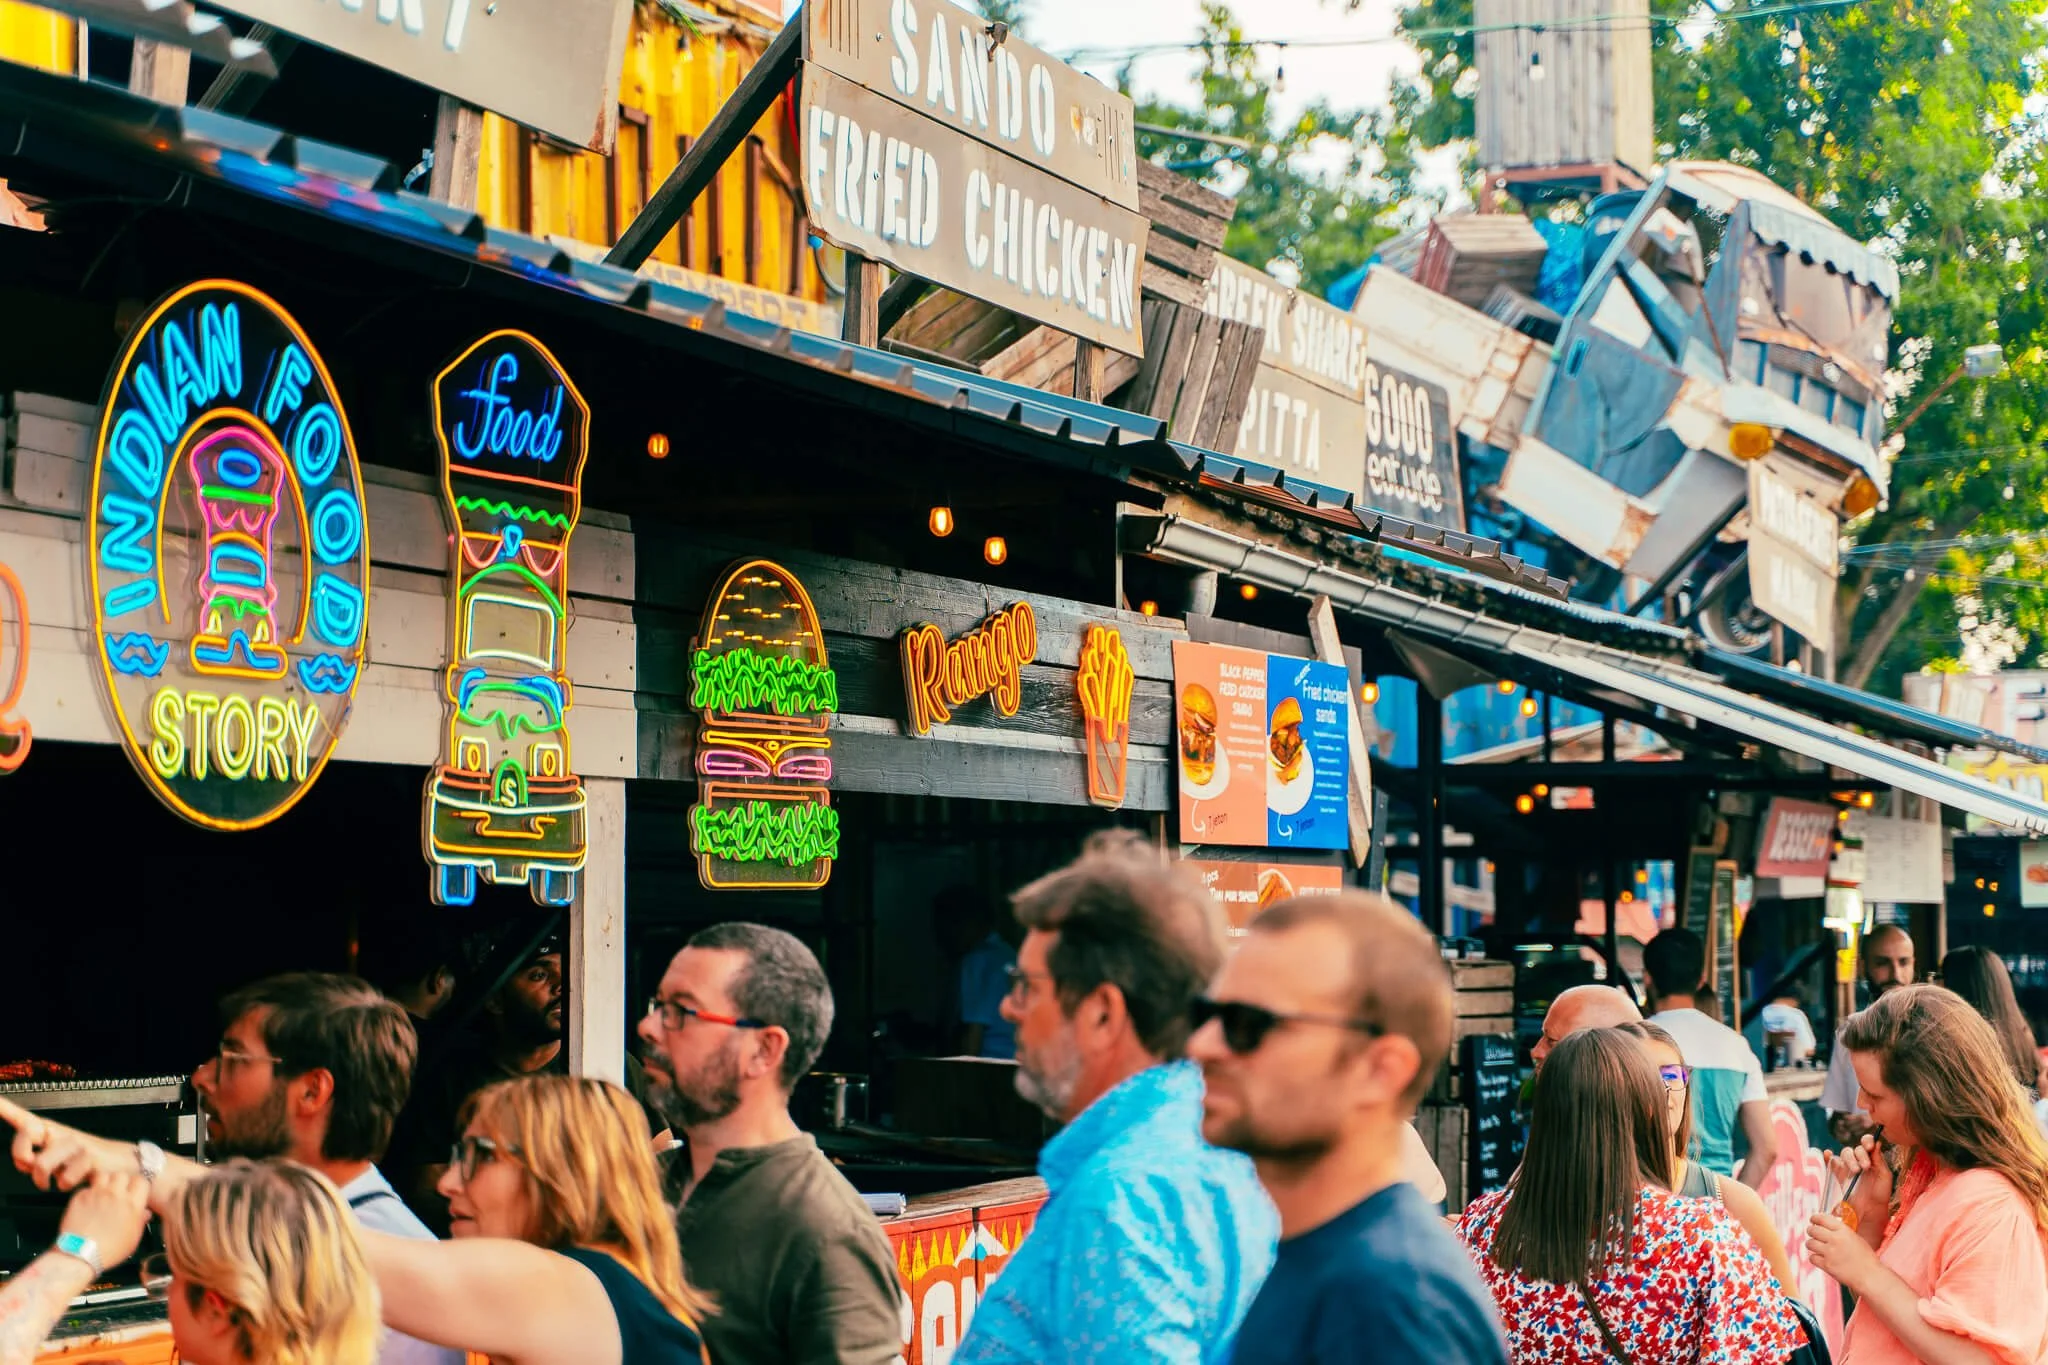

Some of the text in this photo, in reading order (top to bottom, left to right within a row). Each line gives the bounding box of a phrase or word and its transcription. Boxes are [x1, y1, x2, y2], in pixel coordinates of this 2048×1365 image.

[891, 0, 1056, 156] SANDO
[807, 104, 939, 250] FRIED
[964, 168, 1137, 331] CHICKEN
[457, 352, 564, 463] food
[1238, 386, 1321, 475] PITTA
[100, 302, 363, 647] INDIAN FOOD
[905, 600, 1038, 735] Rango
[1302, 679, 1349, 705] Fried chicken
[1315, 704, 1337, 724] sando
[150, 684, 321, 782] STORY
